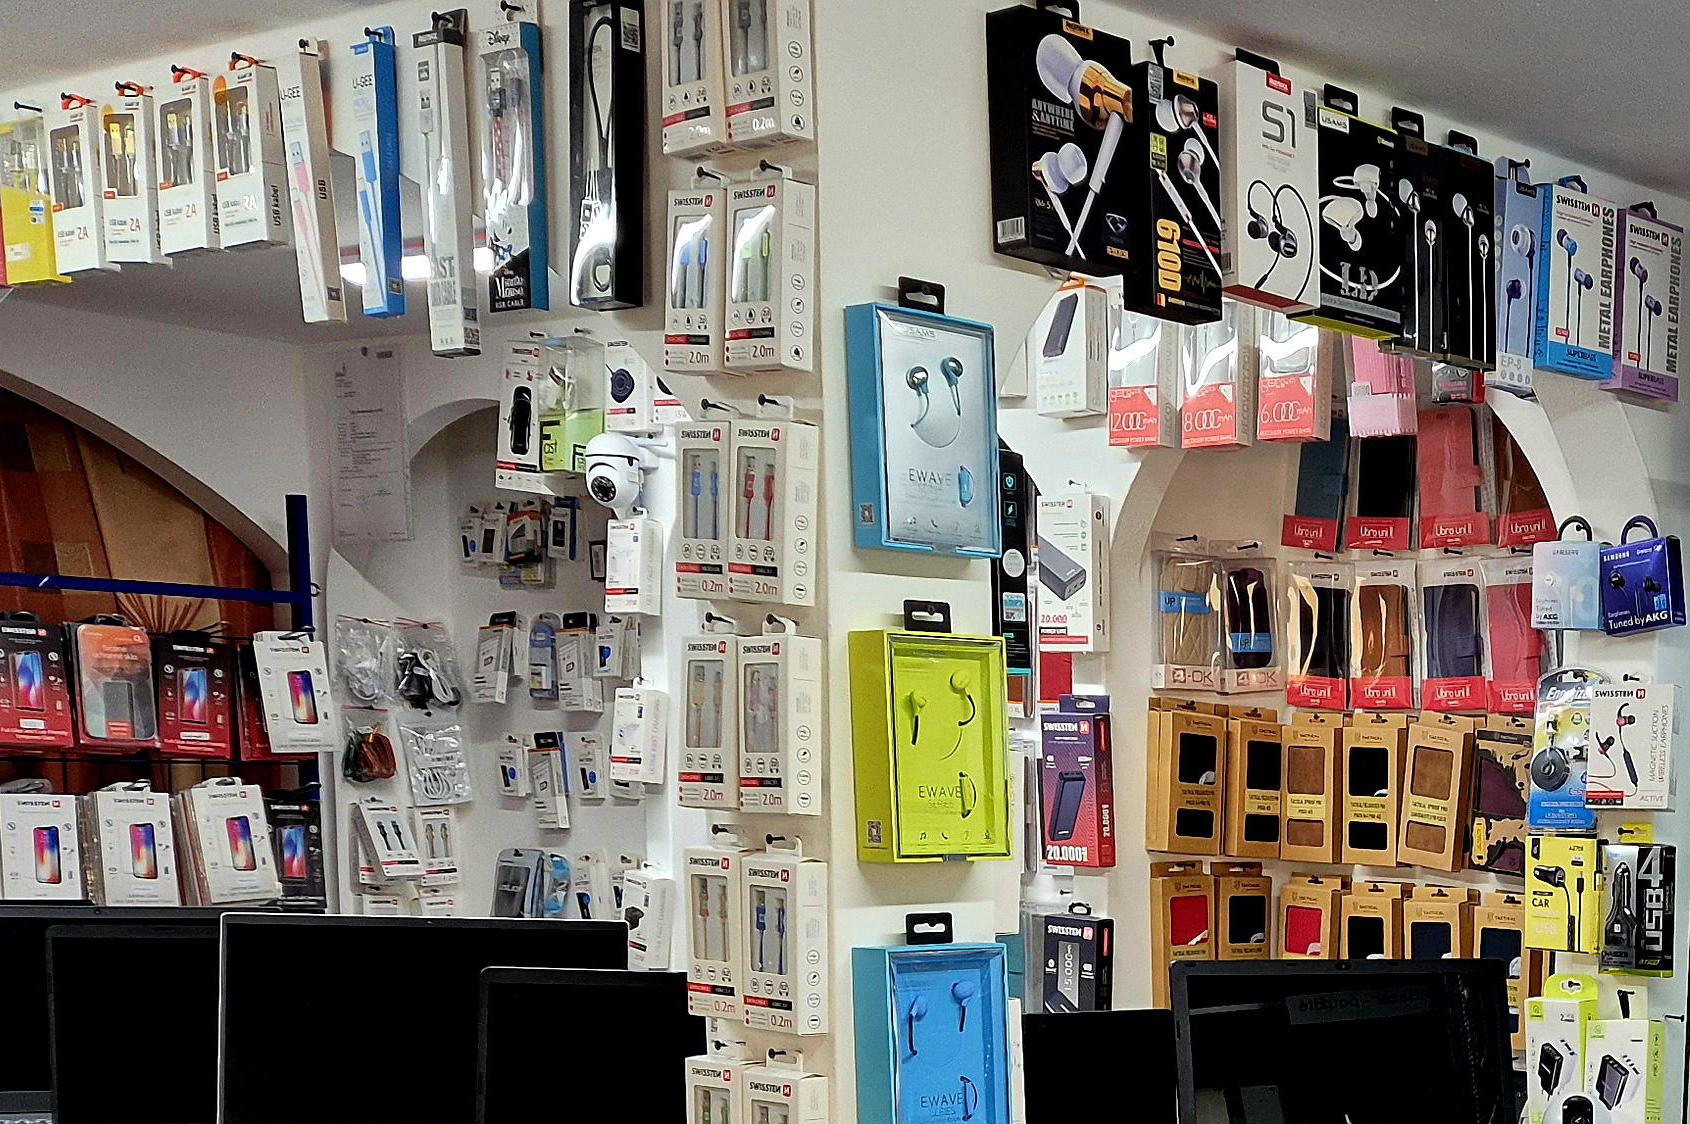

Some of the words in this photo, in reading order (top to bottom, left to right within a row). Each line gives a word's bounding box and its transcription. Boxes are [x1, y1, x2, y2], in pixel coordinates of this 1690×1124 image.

[352, 74, 373, 91] U-GEE
[280, 85, 301, 101] U-GEE
[753, 118, 775, 131] 0.2m
[1262, 100, 1296, 149] S1
[319, 179, 327, 200] USB
[733, 188, 765, 200] SWISSTEN
[1556, 194, 1590, 213] SWISSTEN
[1629, 223, 1661, 241] SWISSTEN
[1156, 218, 1182, 292] 610D
[1600, 207, 1615, 300] EARPHONES
[1668, 237, 1682, 322] EARPHONES
[1598, 301, 1611, 350] METAL
[1666, 322, 1678, 373] METAL
[908, 468, 952, 486] EWAVE
[1608, 618, 1633, 630] Tuned
[1634, 616, 1645, 627] by
[1645, 611, 1668, 623] AKG
[1546, 687, 1591, 701] Energiz
[1594, 690, 1634, 698] SWISSTEN
[1043, 722, 1078, 732] SWISSTEN
[919, 785, 963, 798] EWAVE
[689, 857, 720, 867] SWISSTEN
[748, 868, 780, 879] SWISSTEN
[1531, 898, 1550, 908] CAR
[1047, 924, 1082, 937] SWISSTEN
[691, 1067, 722, 1078] SWISSTEN
[749, 1082, 781, 1094] SWISSTEN
[920, 1092, 964, 1108] EWAVE
